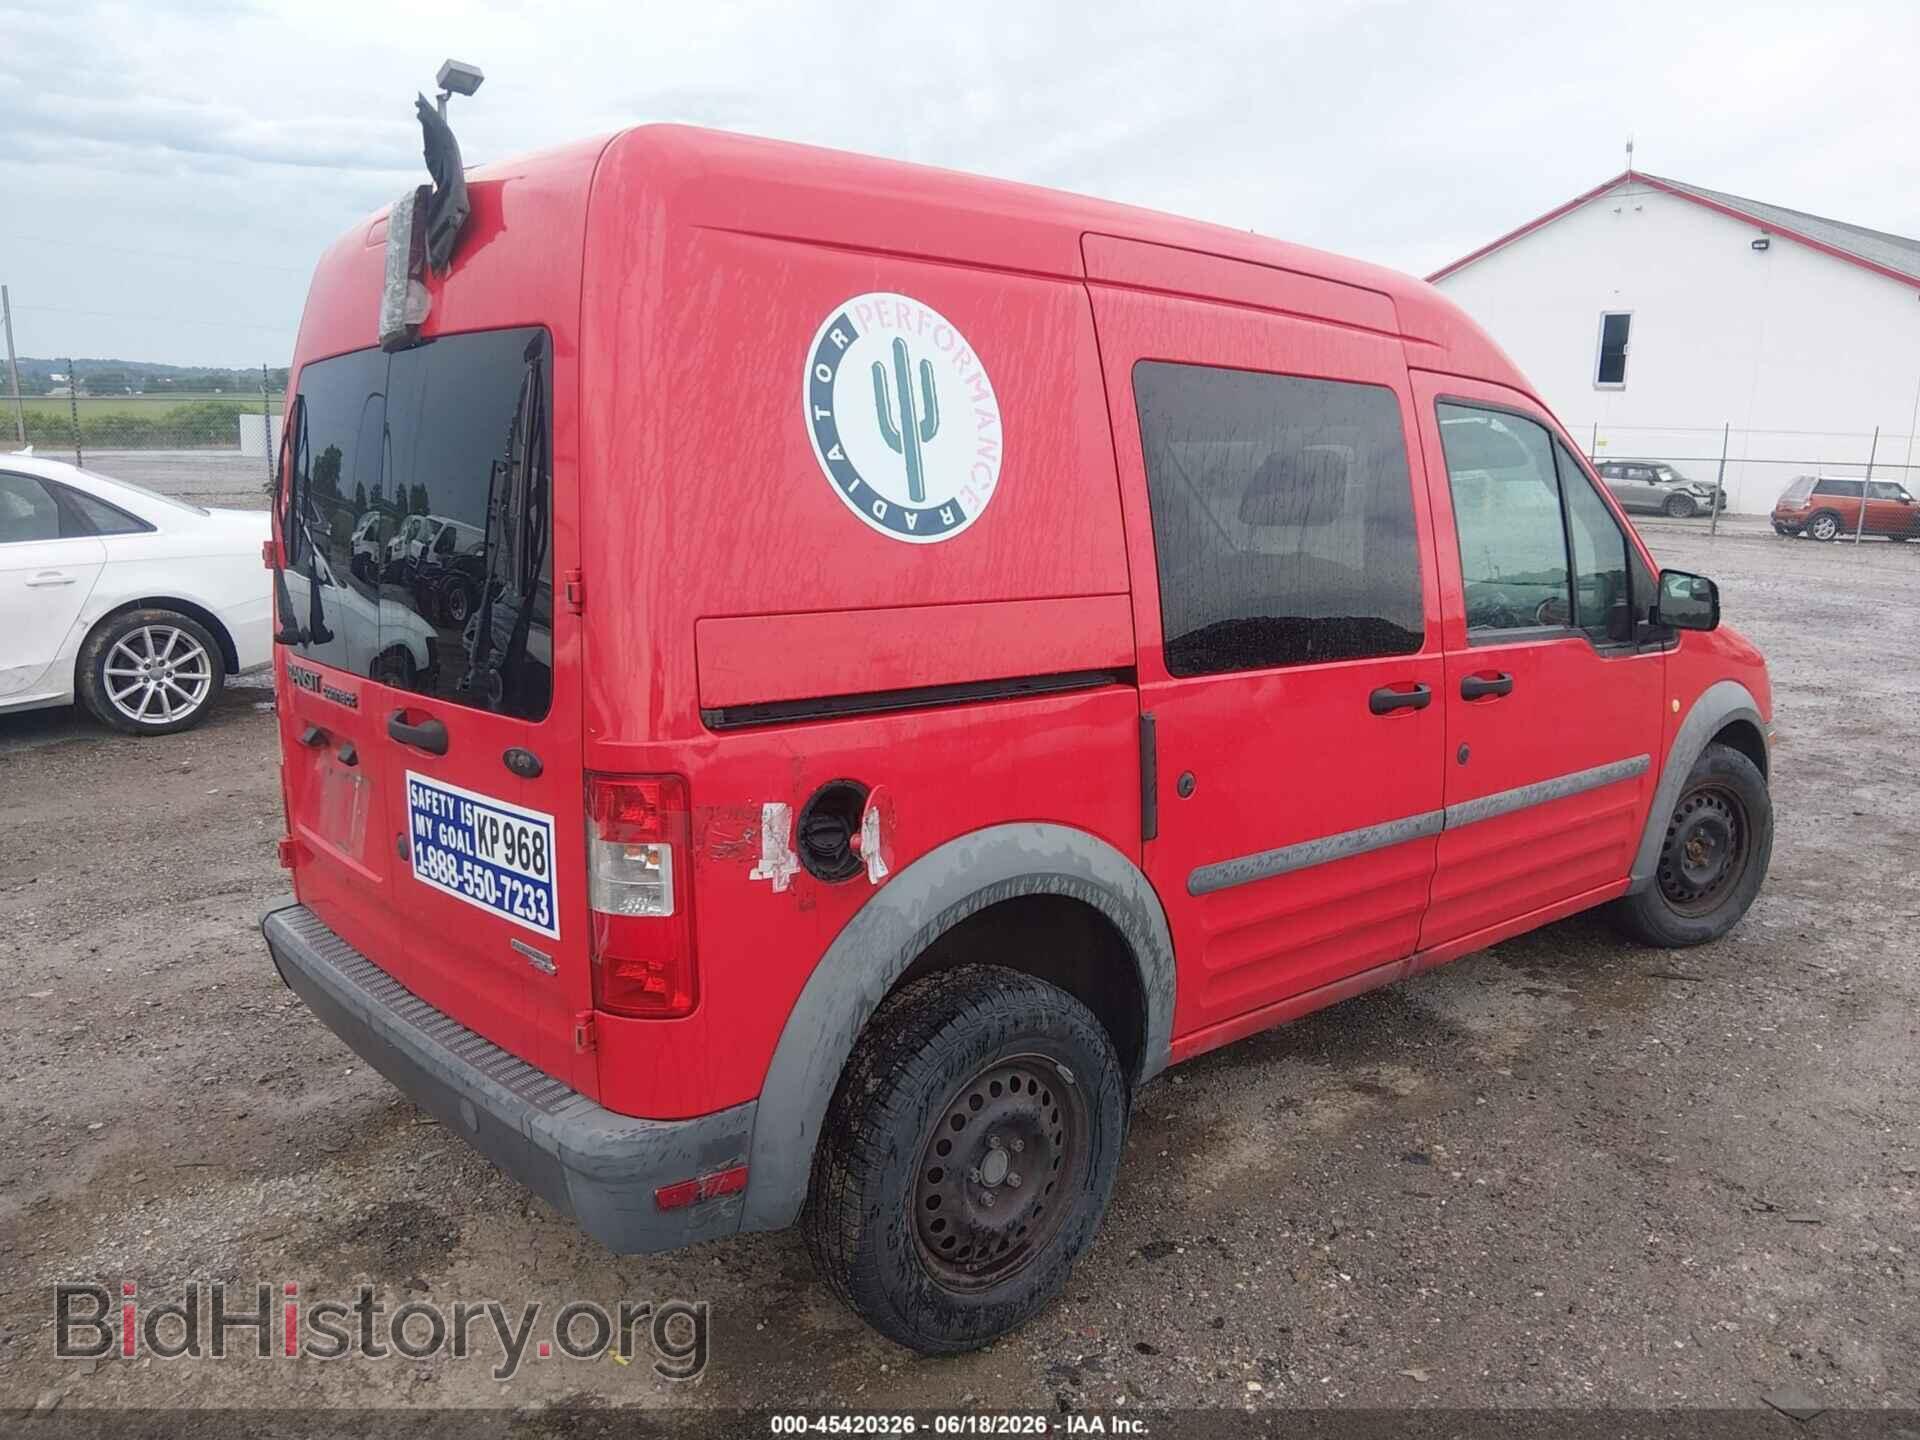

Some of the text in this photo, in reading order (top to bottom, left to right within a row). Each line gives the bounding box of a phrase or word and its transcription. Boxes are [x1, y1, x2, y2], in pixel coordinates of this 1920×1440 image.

[815, 299, 999, 530] RADIATOR PERFORMANCE
[287, 663, 323, 694] RANSIT
[411, 784, 473, 827] SAFETY IS
[415, 812, 474, 857] MY GOAL
[415, 841, 550, 927] 1-888-550-7233
